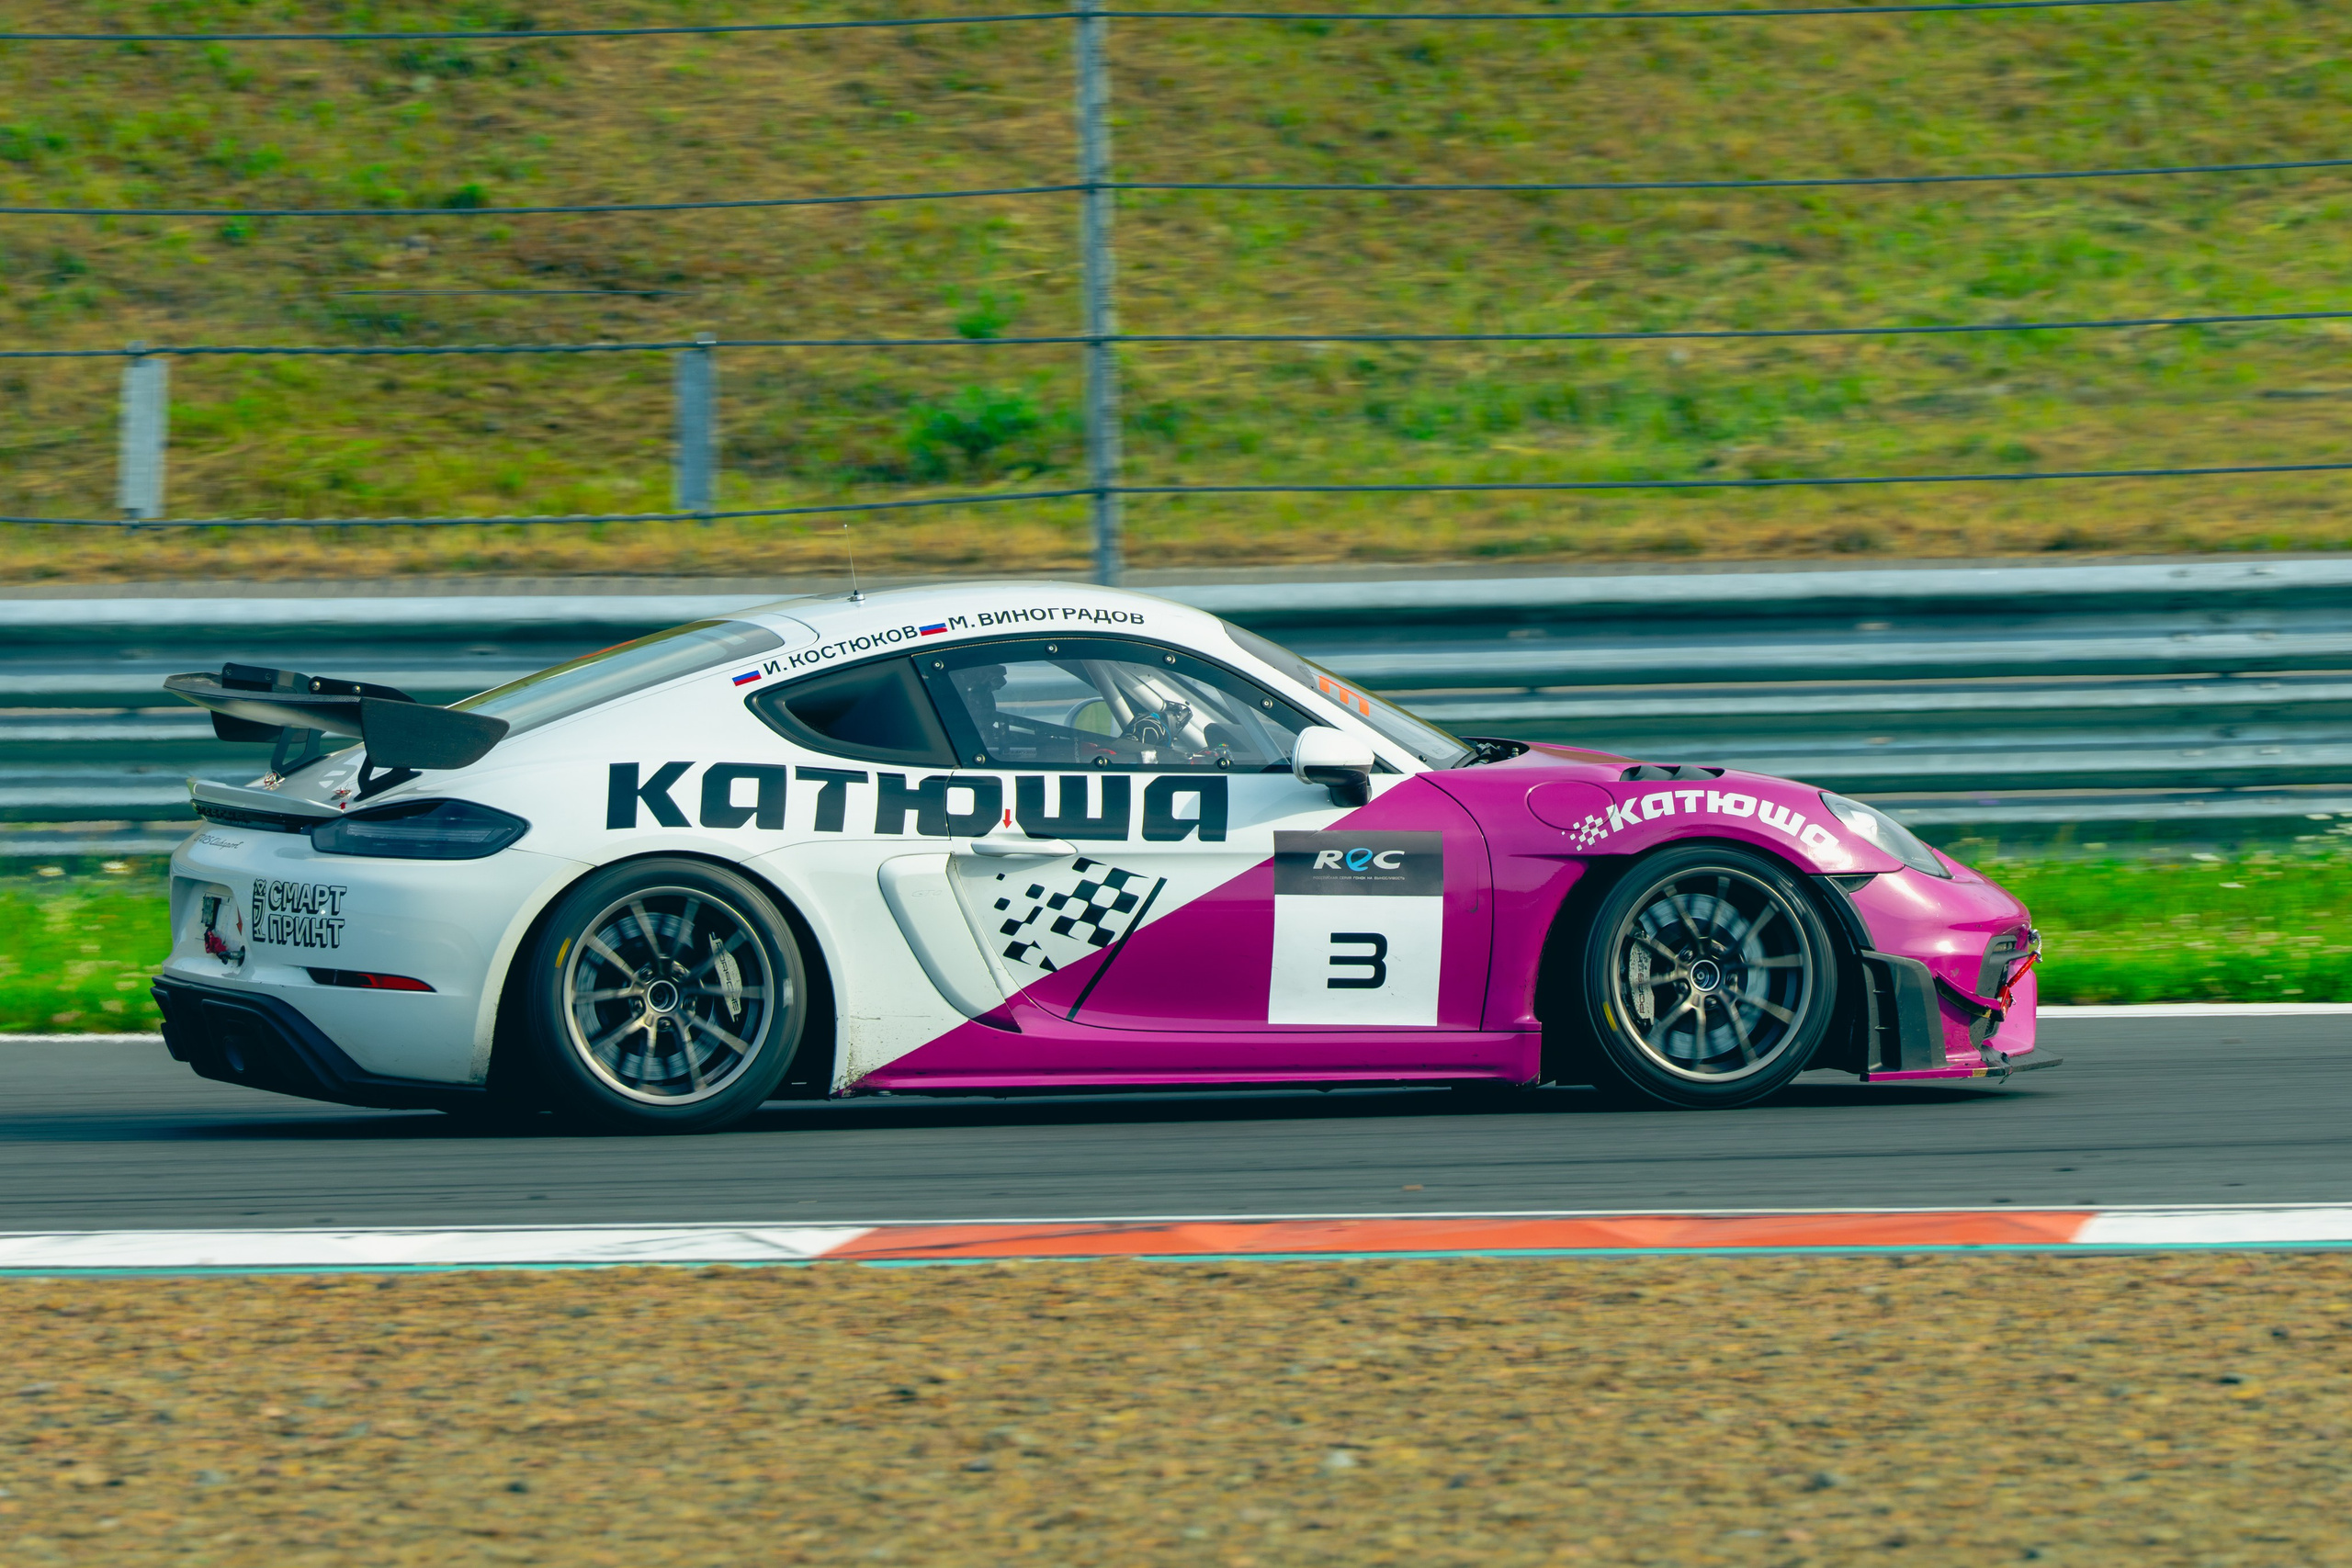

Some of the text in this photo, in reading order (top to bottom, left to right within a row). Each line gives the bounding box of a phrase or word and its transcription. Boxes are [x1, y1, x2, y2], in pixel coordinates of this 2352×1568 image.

[268, 880, 347, 916] СМАРТ
[268, 914, 345, 949] ПРИНТ
[1327, 932, 1388, 989] 3
